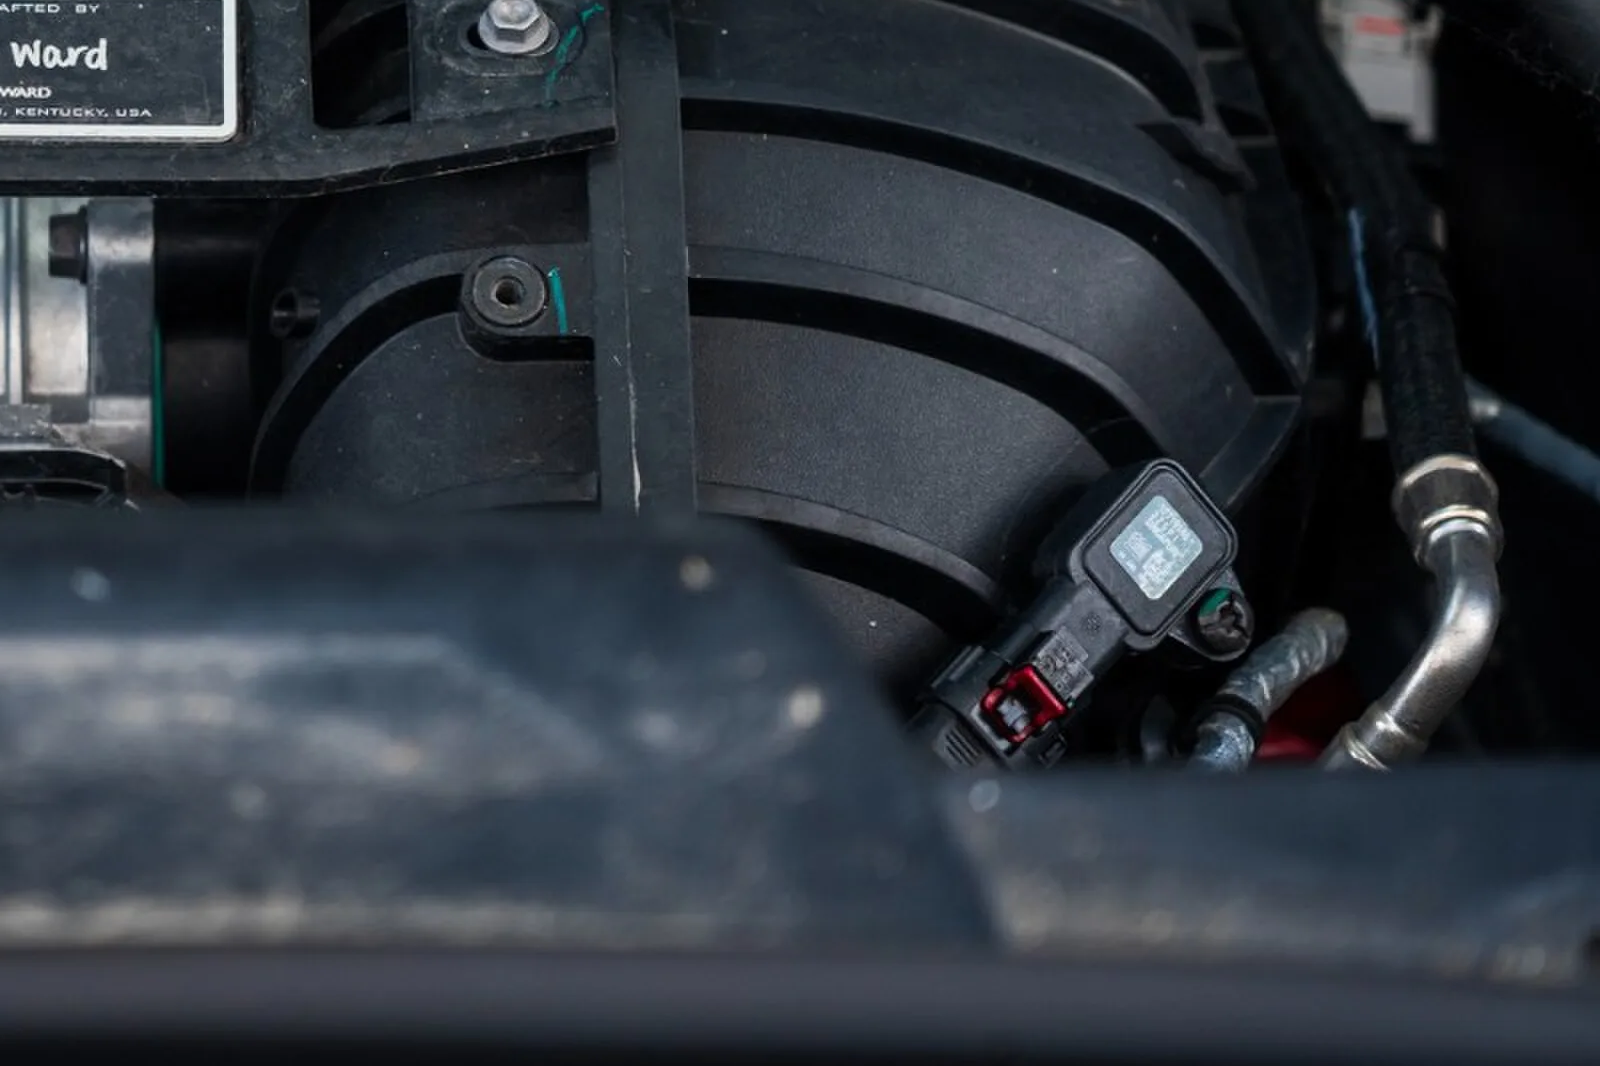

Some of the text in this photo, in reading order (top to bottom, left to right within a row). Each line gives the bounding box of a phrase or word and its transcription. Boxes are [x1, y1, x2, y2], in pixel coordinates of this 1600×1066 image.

[75, 4, 100, 14] BY
[10, 38, 107, 70] Ward
[0, 86, 51, 98] WARD
[15, 107, 109, 118] KENTUCKY,
[115, 108, 152, 118] USA
